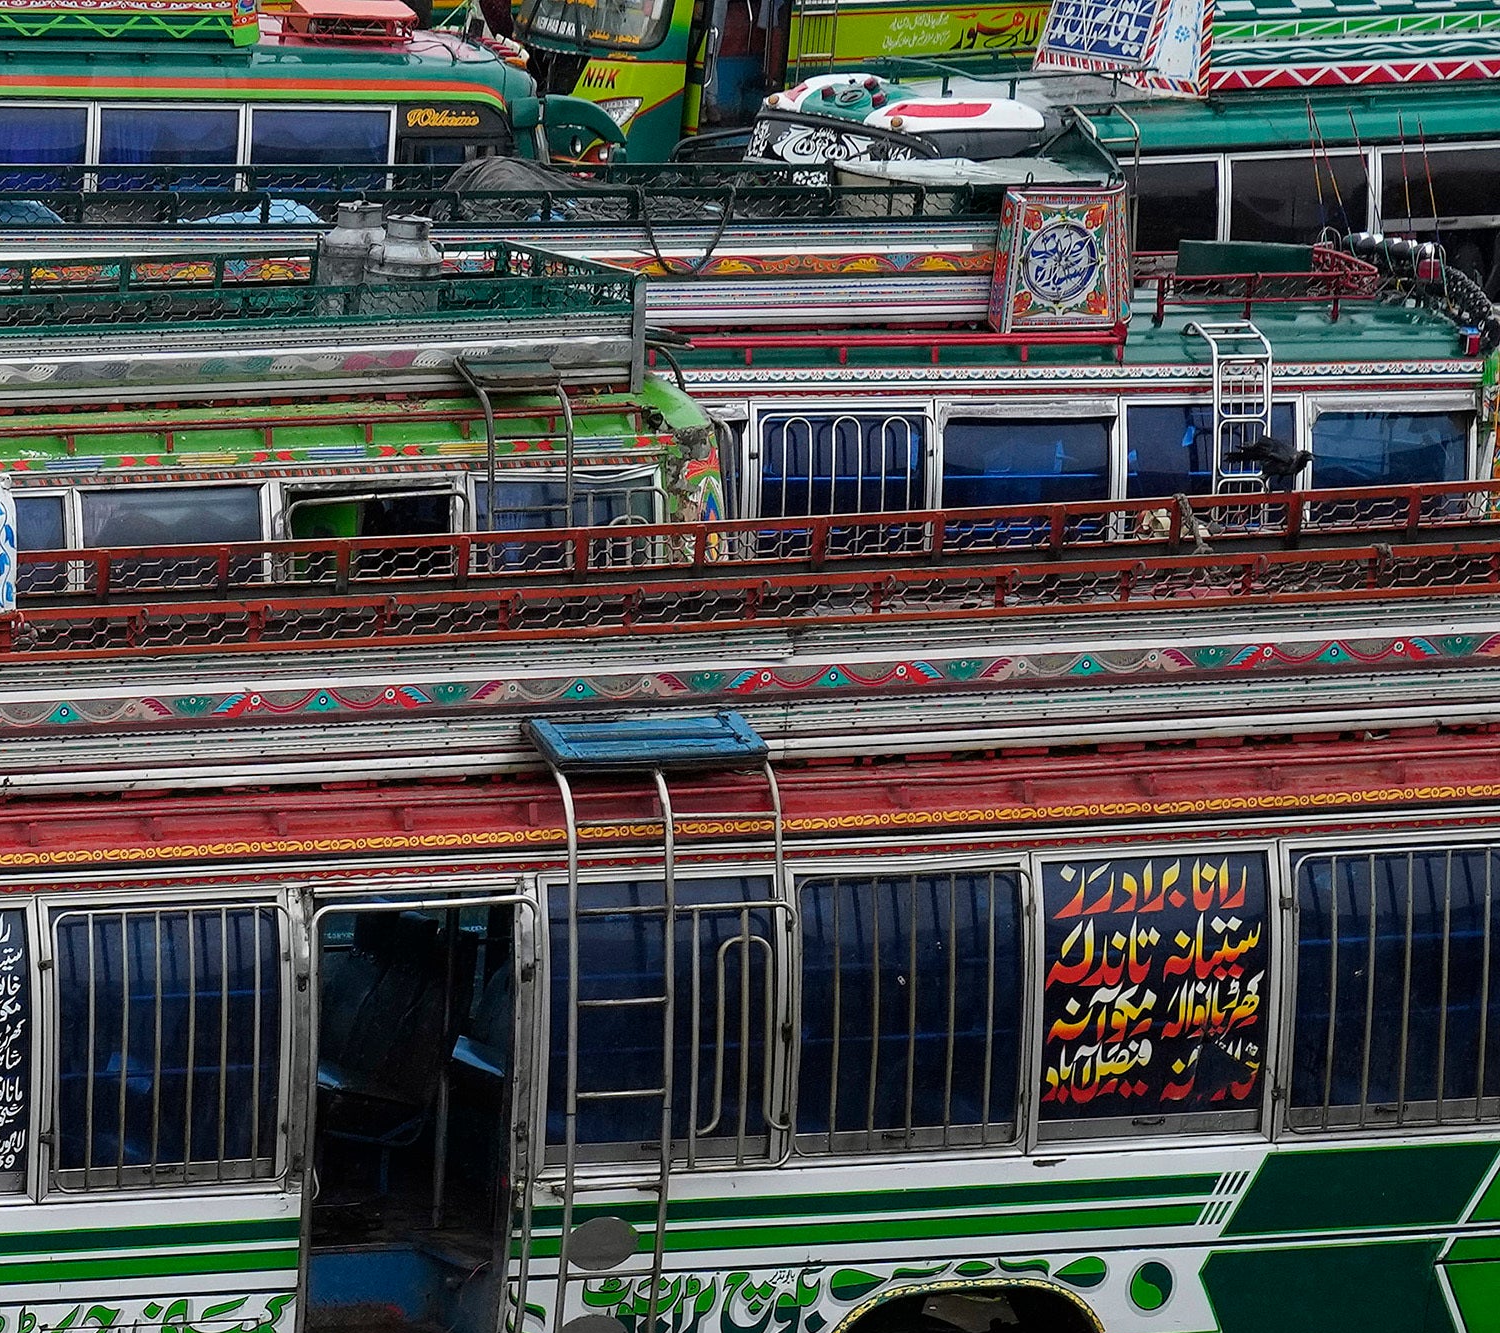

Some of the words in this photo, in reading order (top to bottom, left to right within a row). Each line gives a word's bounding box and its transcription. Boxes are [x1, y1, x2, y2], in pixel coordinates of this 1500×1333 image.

[583, 67, 620, 89] NHK
[1052, 858, 1188, 920] برادرز
[1192, 857, 1248, 912] رانا
[1163, 912, 1262, 983] ستیانہ
